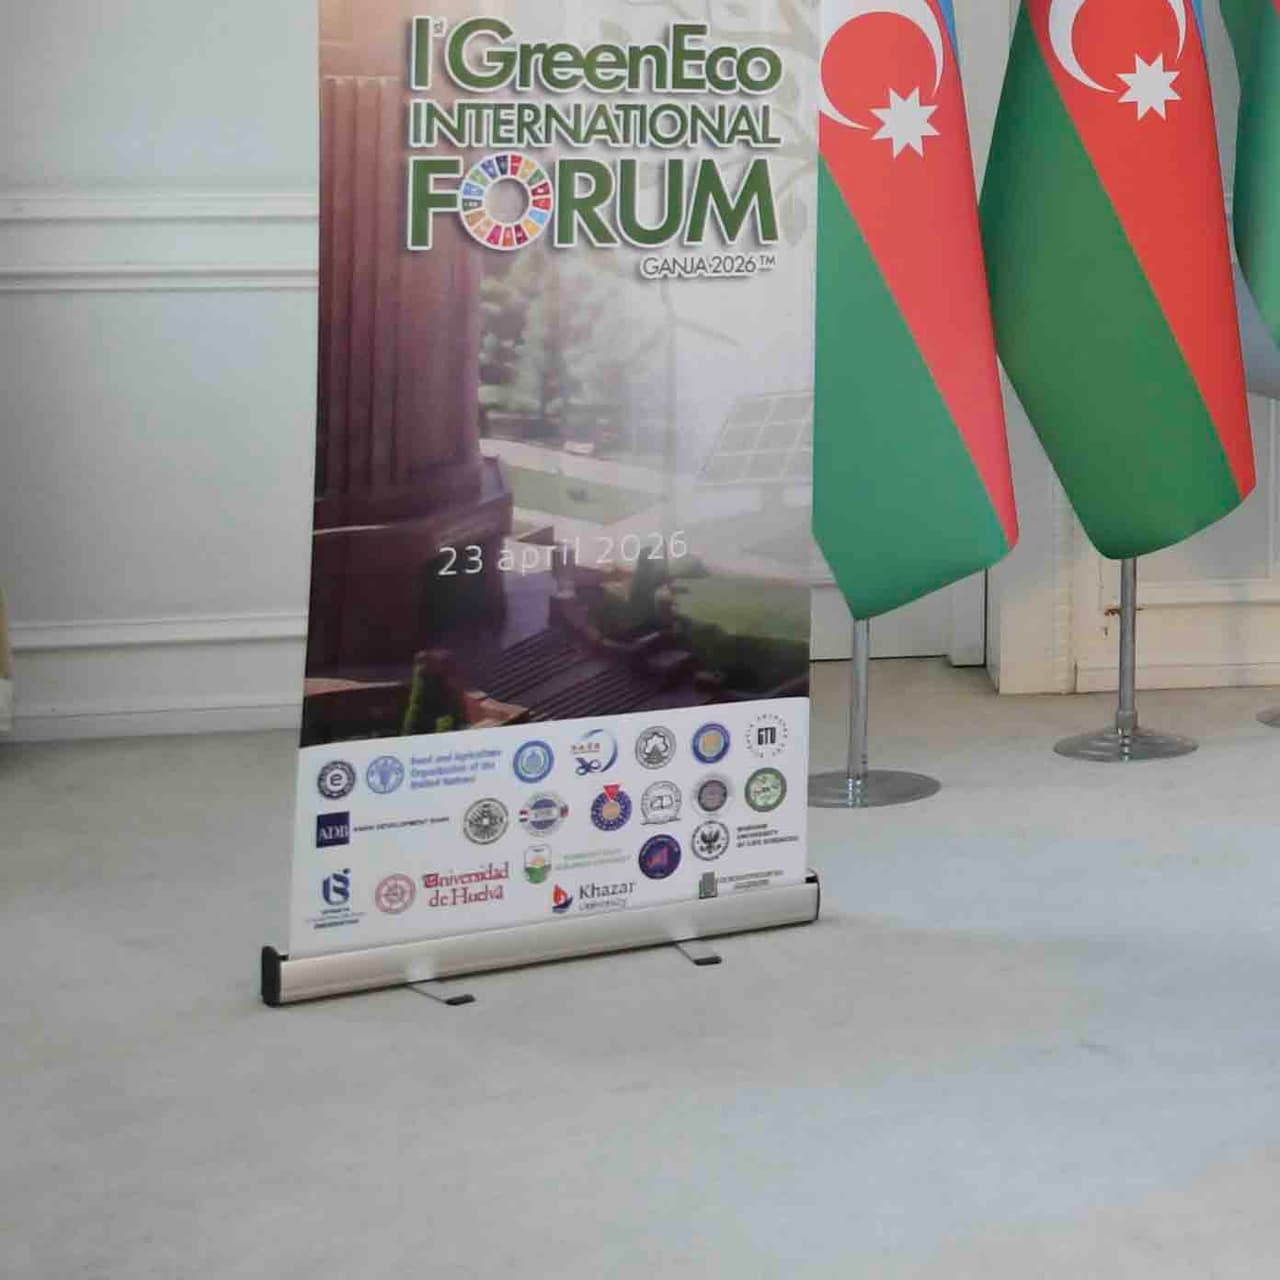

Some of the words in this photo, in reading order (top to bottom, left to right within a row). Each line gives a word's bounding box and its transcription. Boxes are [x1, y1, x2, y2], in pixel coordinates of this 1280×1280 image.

[446, 16, 784, 94] GreenEco
[410, 101, 782, 147] INTERNATIONAL
[408, 153, 781, 250] FORUM
[437, 545, 484, 576] 23
[497, 536, 580, 575] april
[596, 530, 688, 564] 2026
[320, 824, 349, 840] ADB
[579, 882, 635, 900] Khazar
